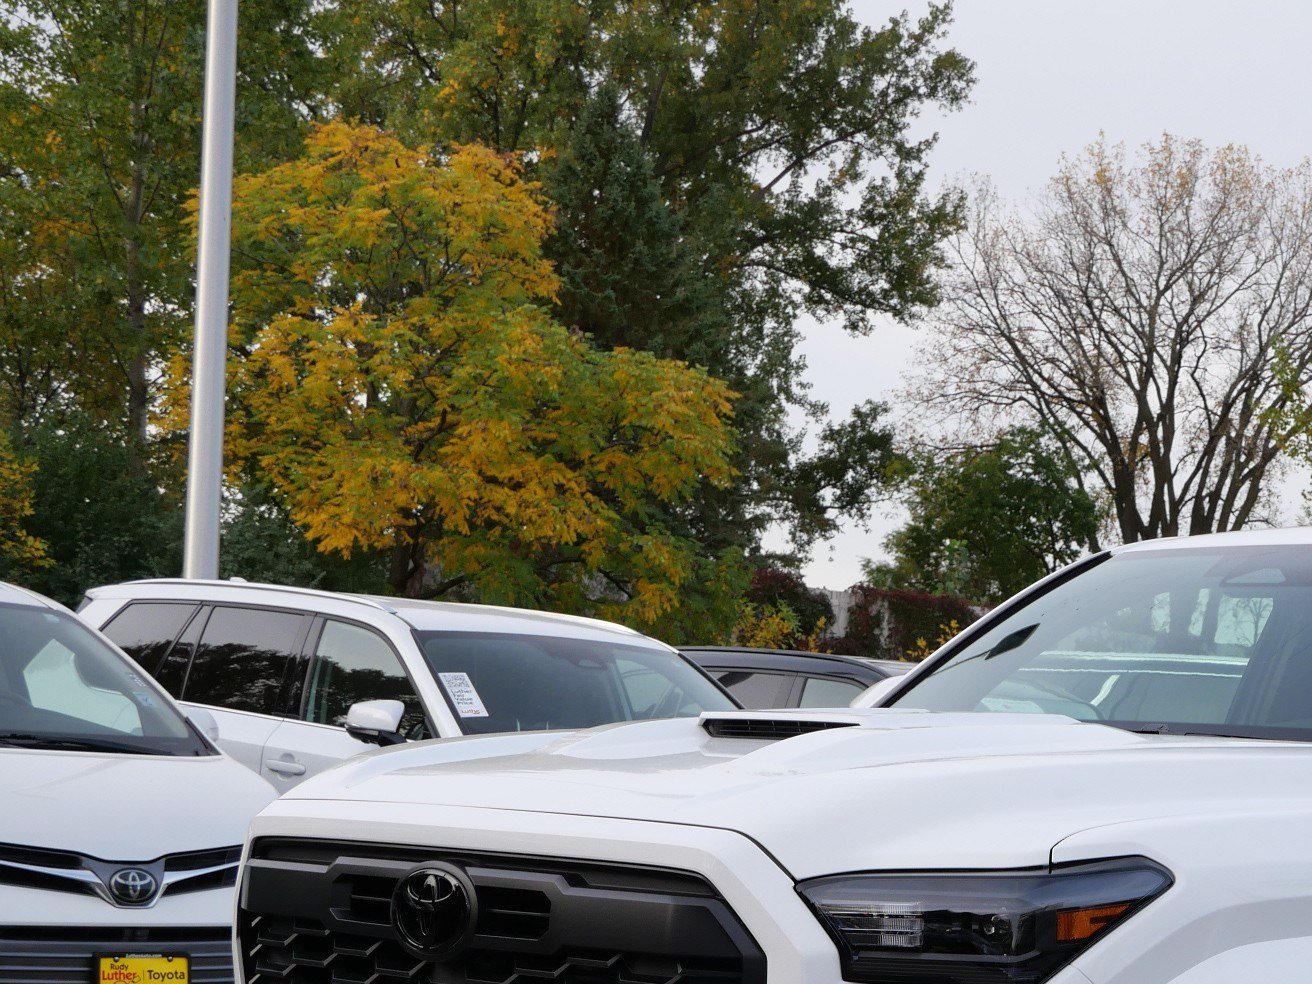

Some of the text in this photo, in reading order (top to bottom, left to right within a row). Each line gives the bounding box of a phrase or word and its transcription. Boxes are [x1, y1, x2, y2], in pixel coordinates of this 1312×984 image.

[110, 963, 129, 971] Rudy
[102, 970, 136, 980] Luther
[147, 970, 185, 982] Toyota
